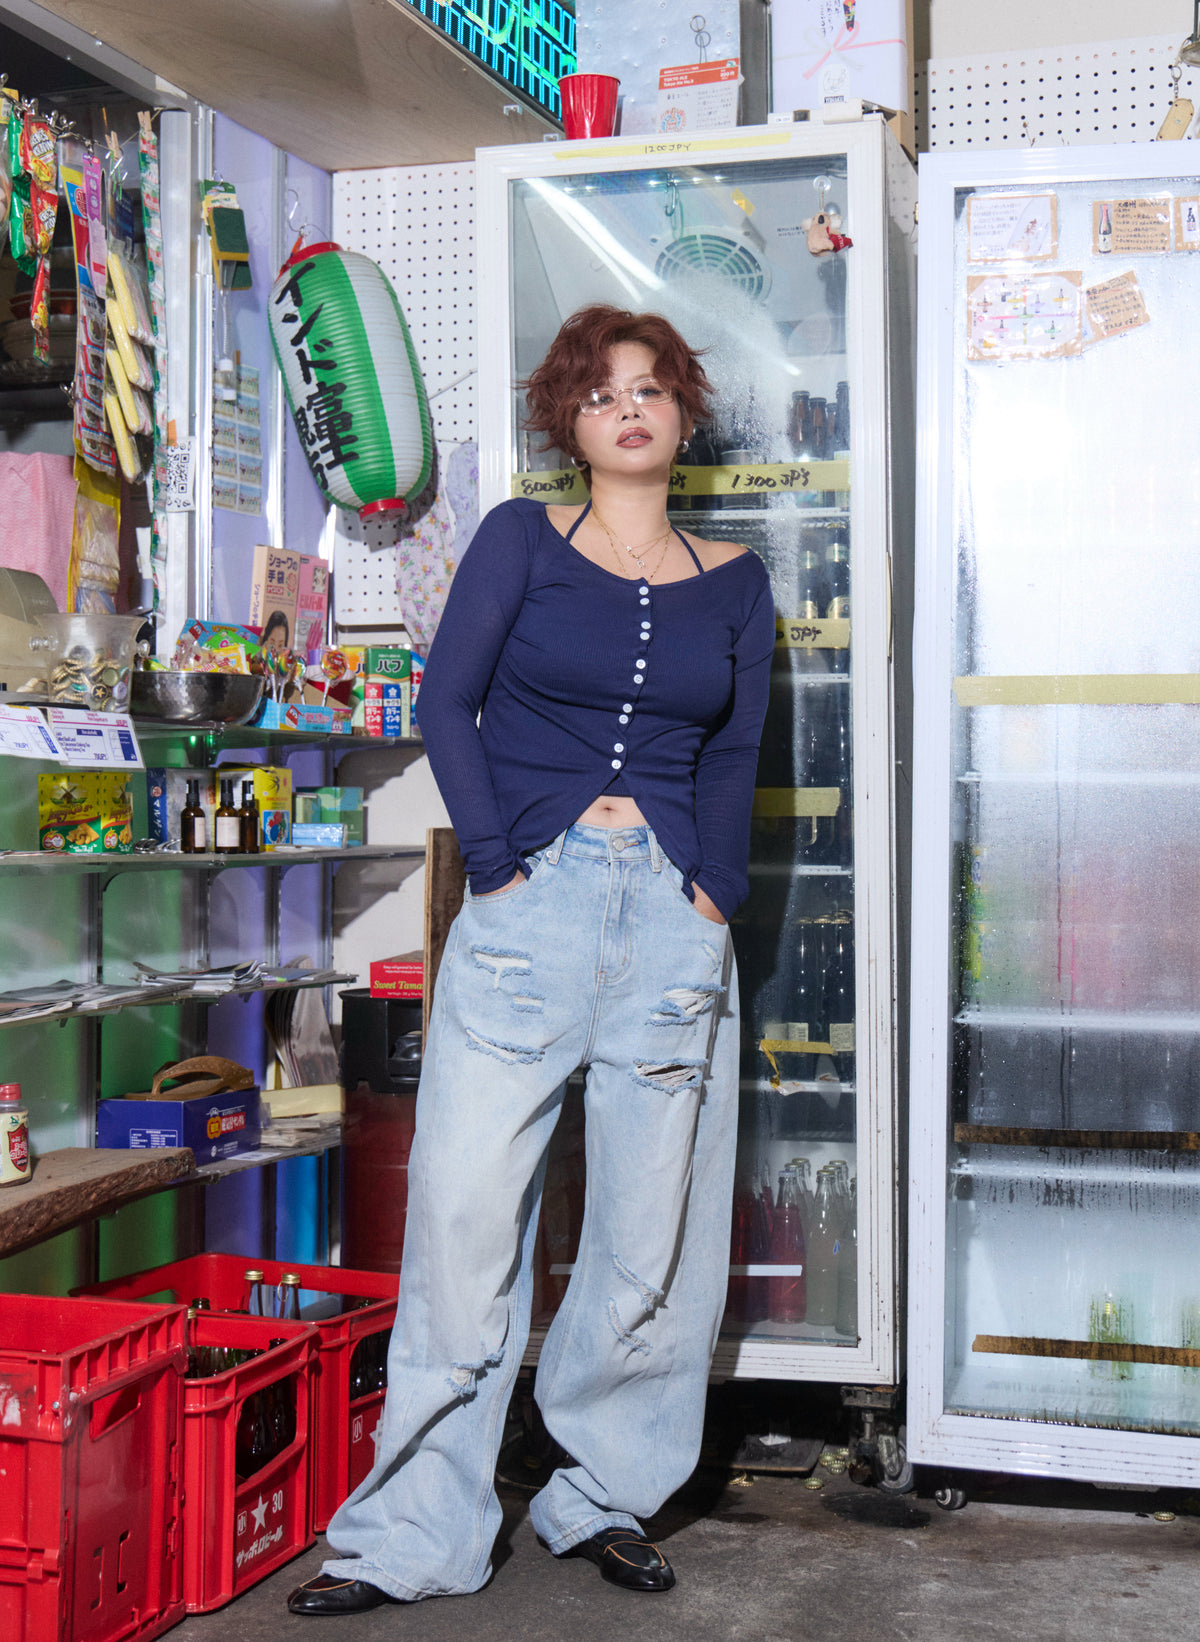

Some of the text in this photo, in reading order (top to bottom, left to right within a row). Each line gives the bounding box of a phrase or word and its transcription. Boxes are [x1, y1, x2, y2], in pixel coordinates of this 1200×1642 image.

[521, 472, 575, 496] 800JPY
[669, 471, 688, 492] PY
[268, 553, 298, 572] ショーワの
[267, 569, 285, 585] 手袋
[373, 980, 423, 990] Sweet Tama
[272, 1489, 283, 1514] 30
[236, 1524, 283, 1568] サッポロビール
